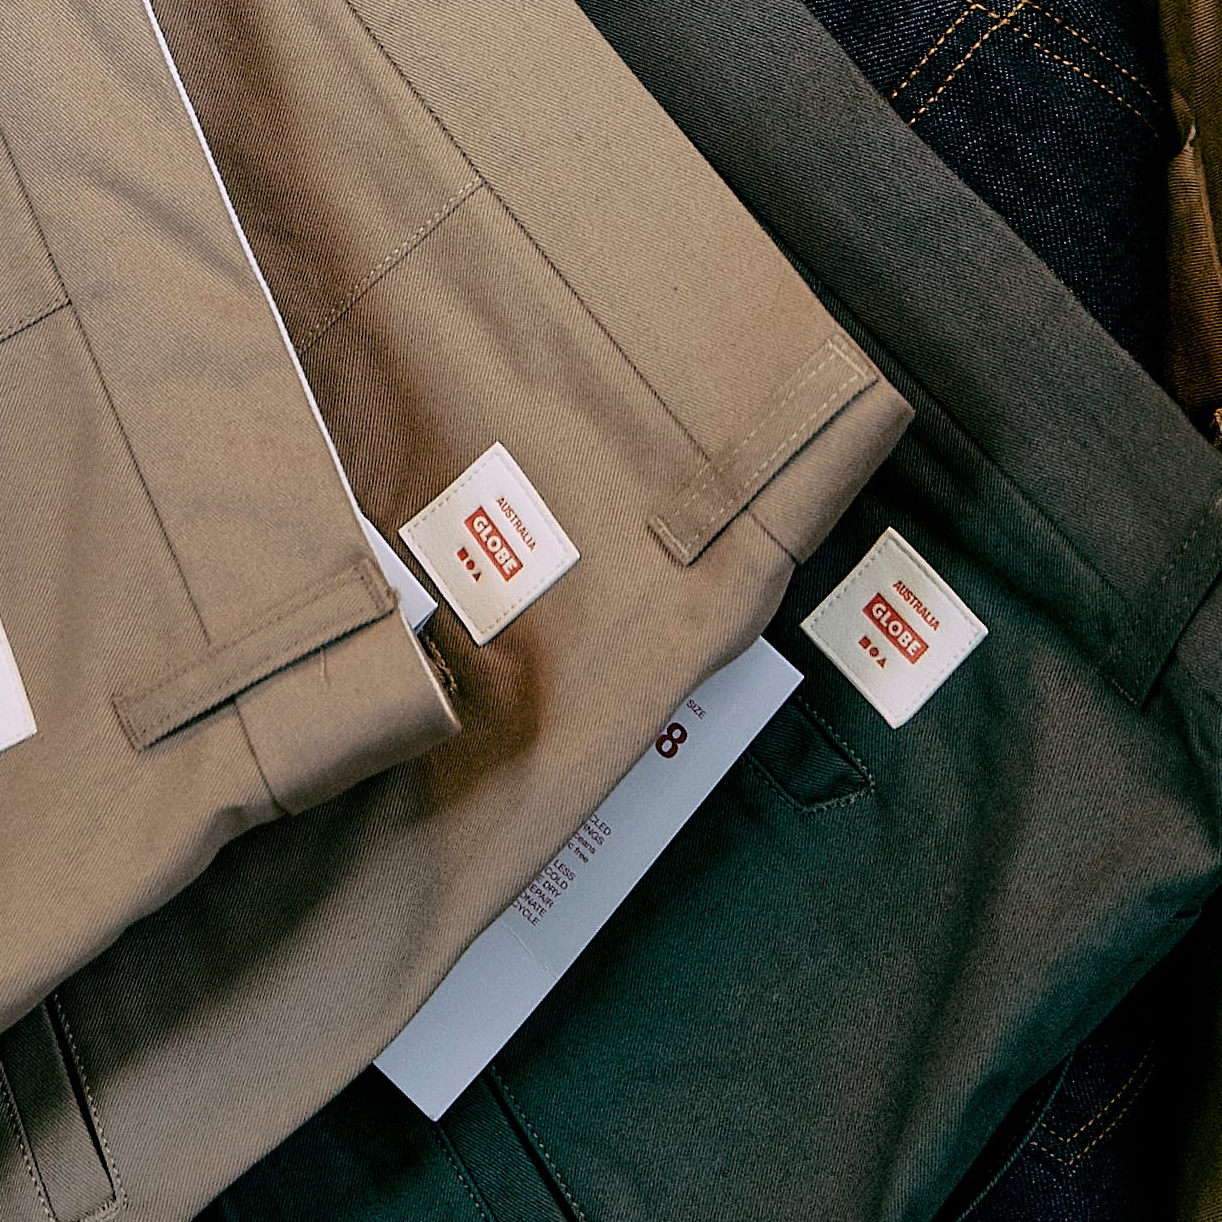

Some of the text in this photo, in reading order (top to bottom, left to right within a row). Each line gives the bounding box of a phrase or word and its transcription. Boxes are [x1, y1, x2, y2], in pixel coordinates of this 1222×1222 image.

[495, 495, 537, 552] AUSTRALIA
[469, 513, 519, 576] GLOBE
[892, 579, 940, 632] AUSTRALIA
[869, 600, 922, 658] GLOBE
[685, 698, 707, 721] SIZE
[655, 722, 688, 759] 8
[581, 822, 605, 846] INGS
[586, 811, 612, 837] CLED
[572, 846, 590, 864] free
[543, 865, 569, 891] COLD
[552, 858, 577, 882] LESS
[528, 883, 554, 910] EPAIR
[542, 879, 563, 898] DRY
[512, 898, 541, 927] CYCLE
[519, 890, 548, 918] ONATE
